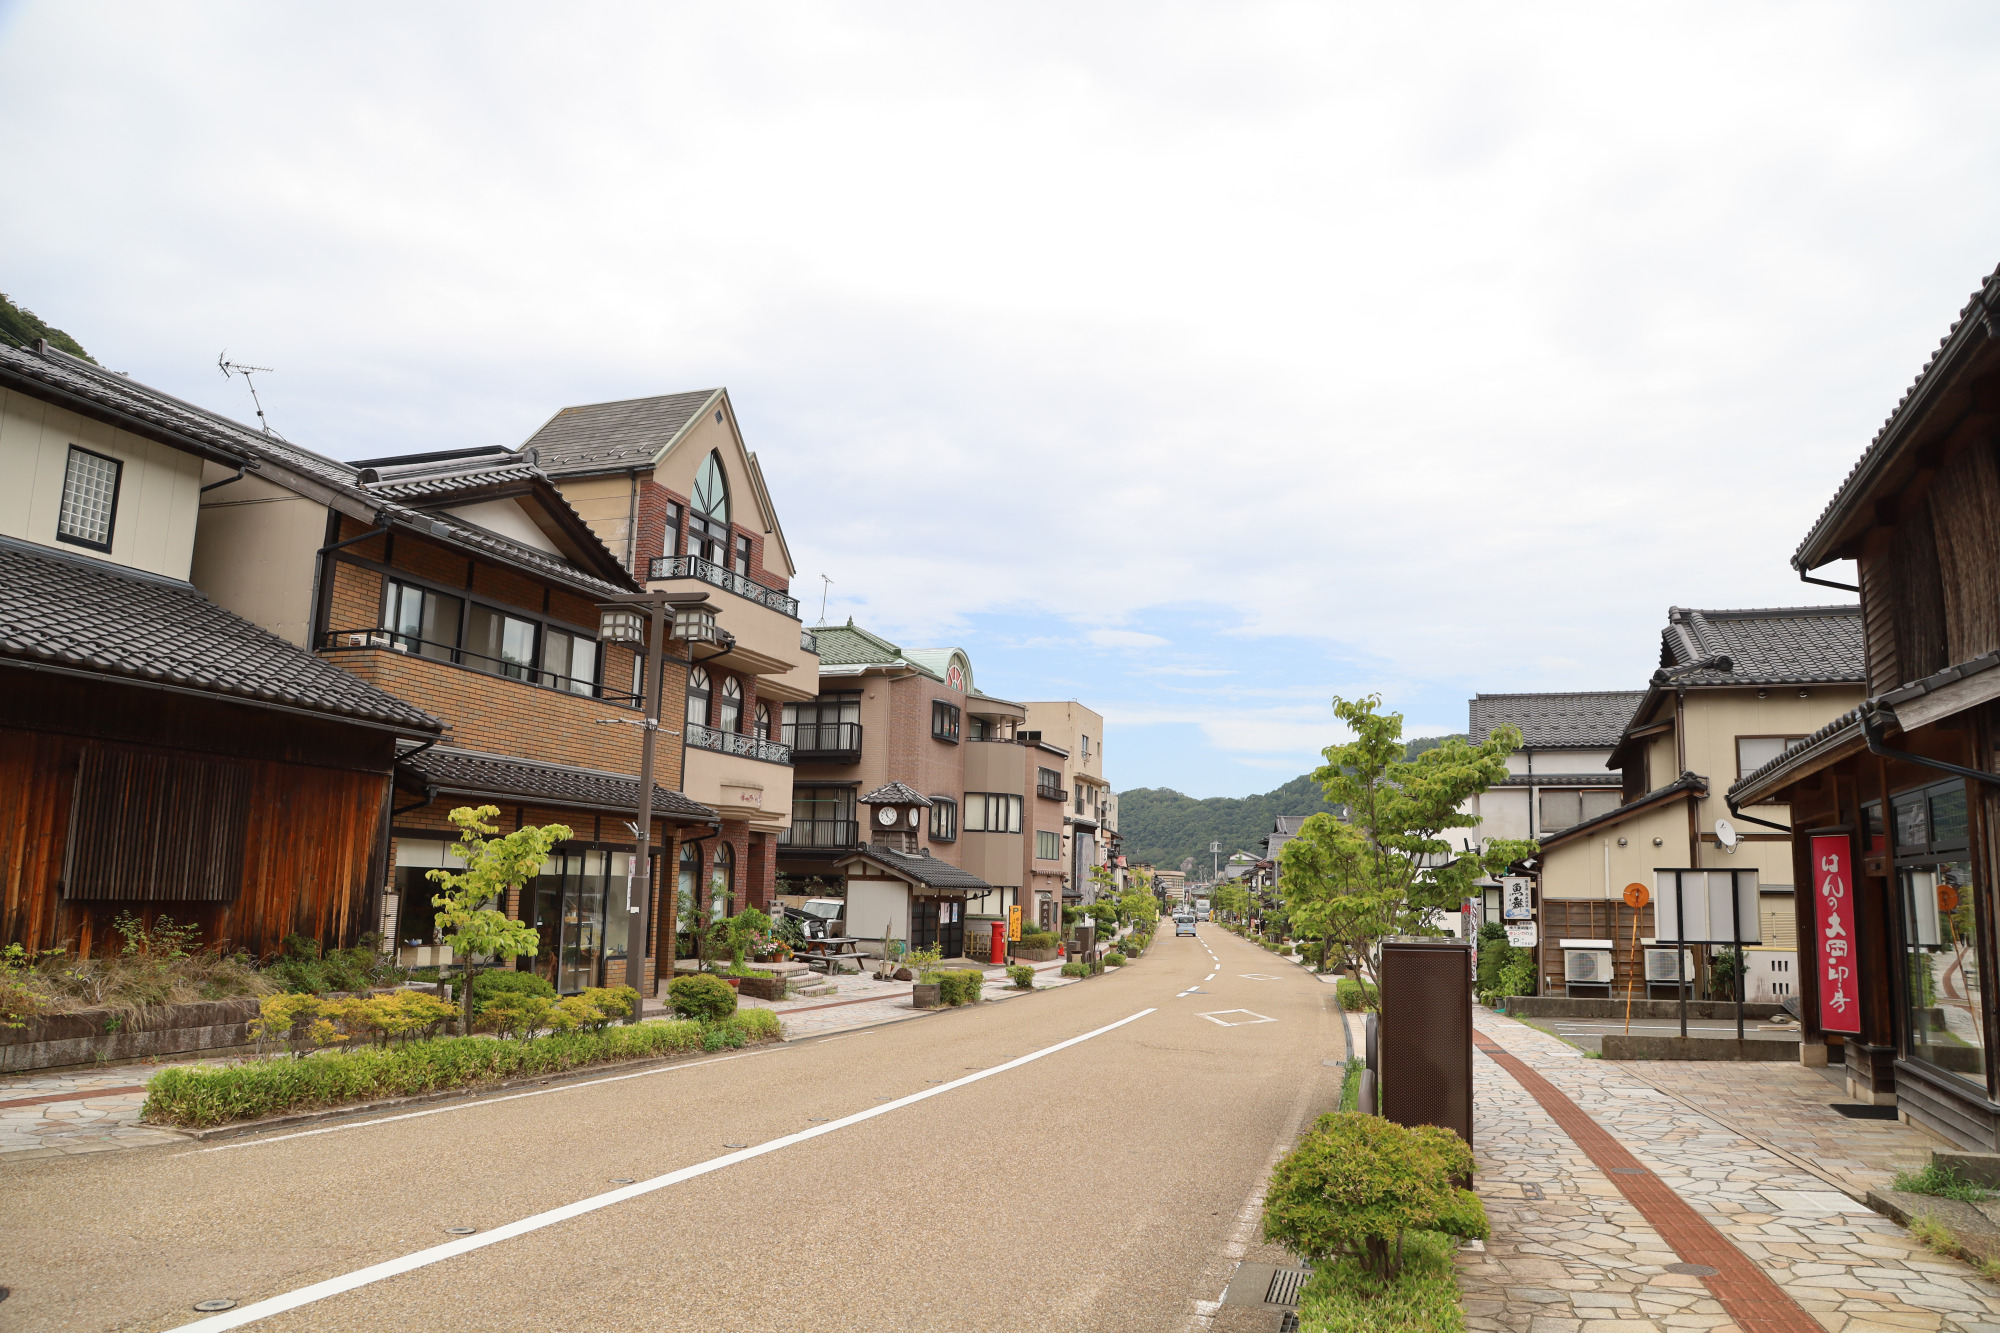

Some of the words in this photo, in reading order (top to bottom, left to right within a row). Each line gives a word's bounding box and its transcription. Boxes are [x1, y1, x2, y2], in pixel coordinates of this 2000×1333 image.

[1513, 937, 1520, 945] P
[1822, 854, 1851, 1013] はんの大岡印房
